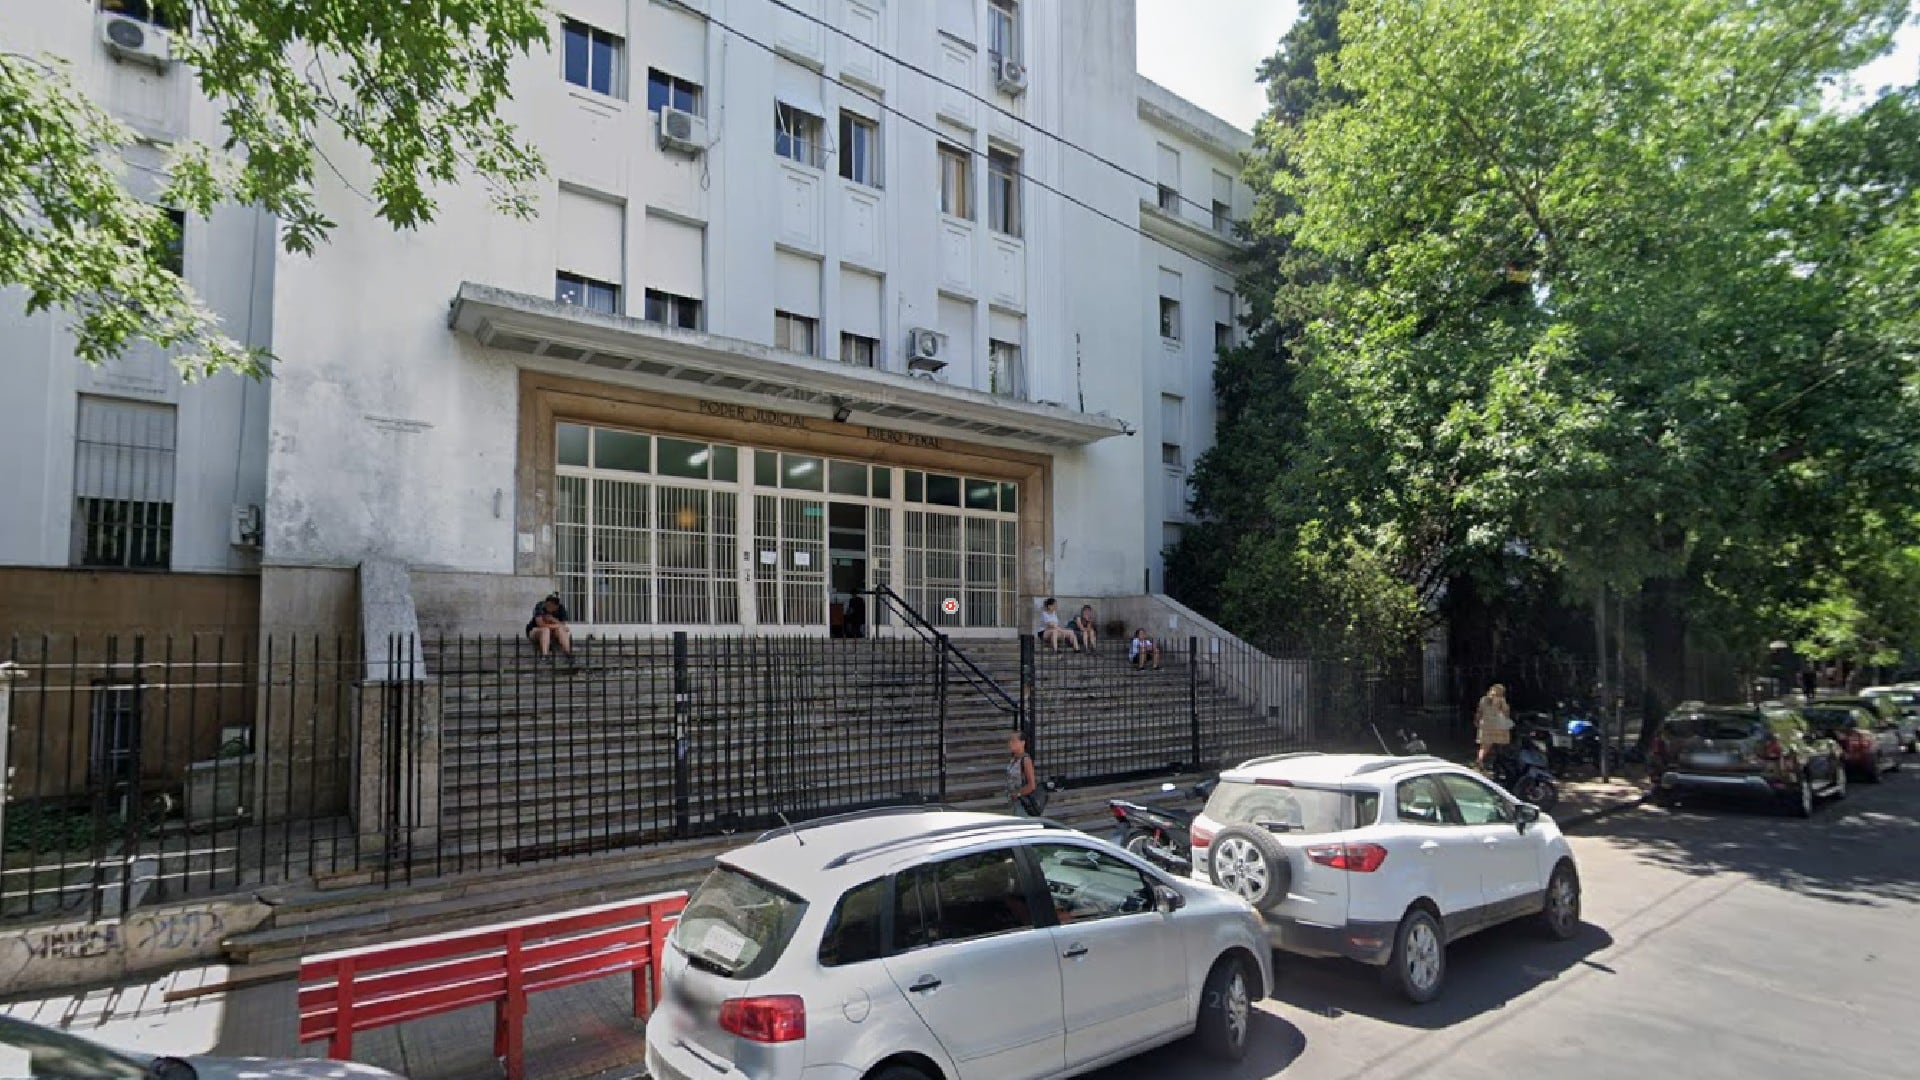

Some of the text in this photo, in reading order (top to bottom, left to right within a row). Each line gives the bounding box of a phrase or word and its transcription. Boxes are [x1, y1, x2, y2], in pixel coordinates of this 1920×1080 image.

[699, 400, 807, 428] PODER JUDICIAL
[866, 427, 943, 450] FUERO PENAL
